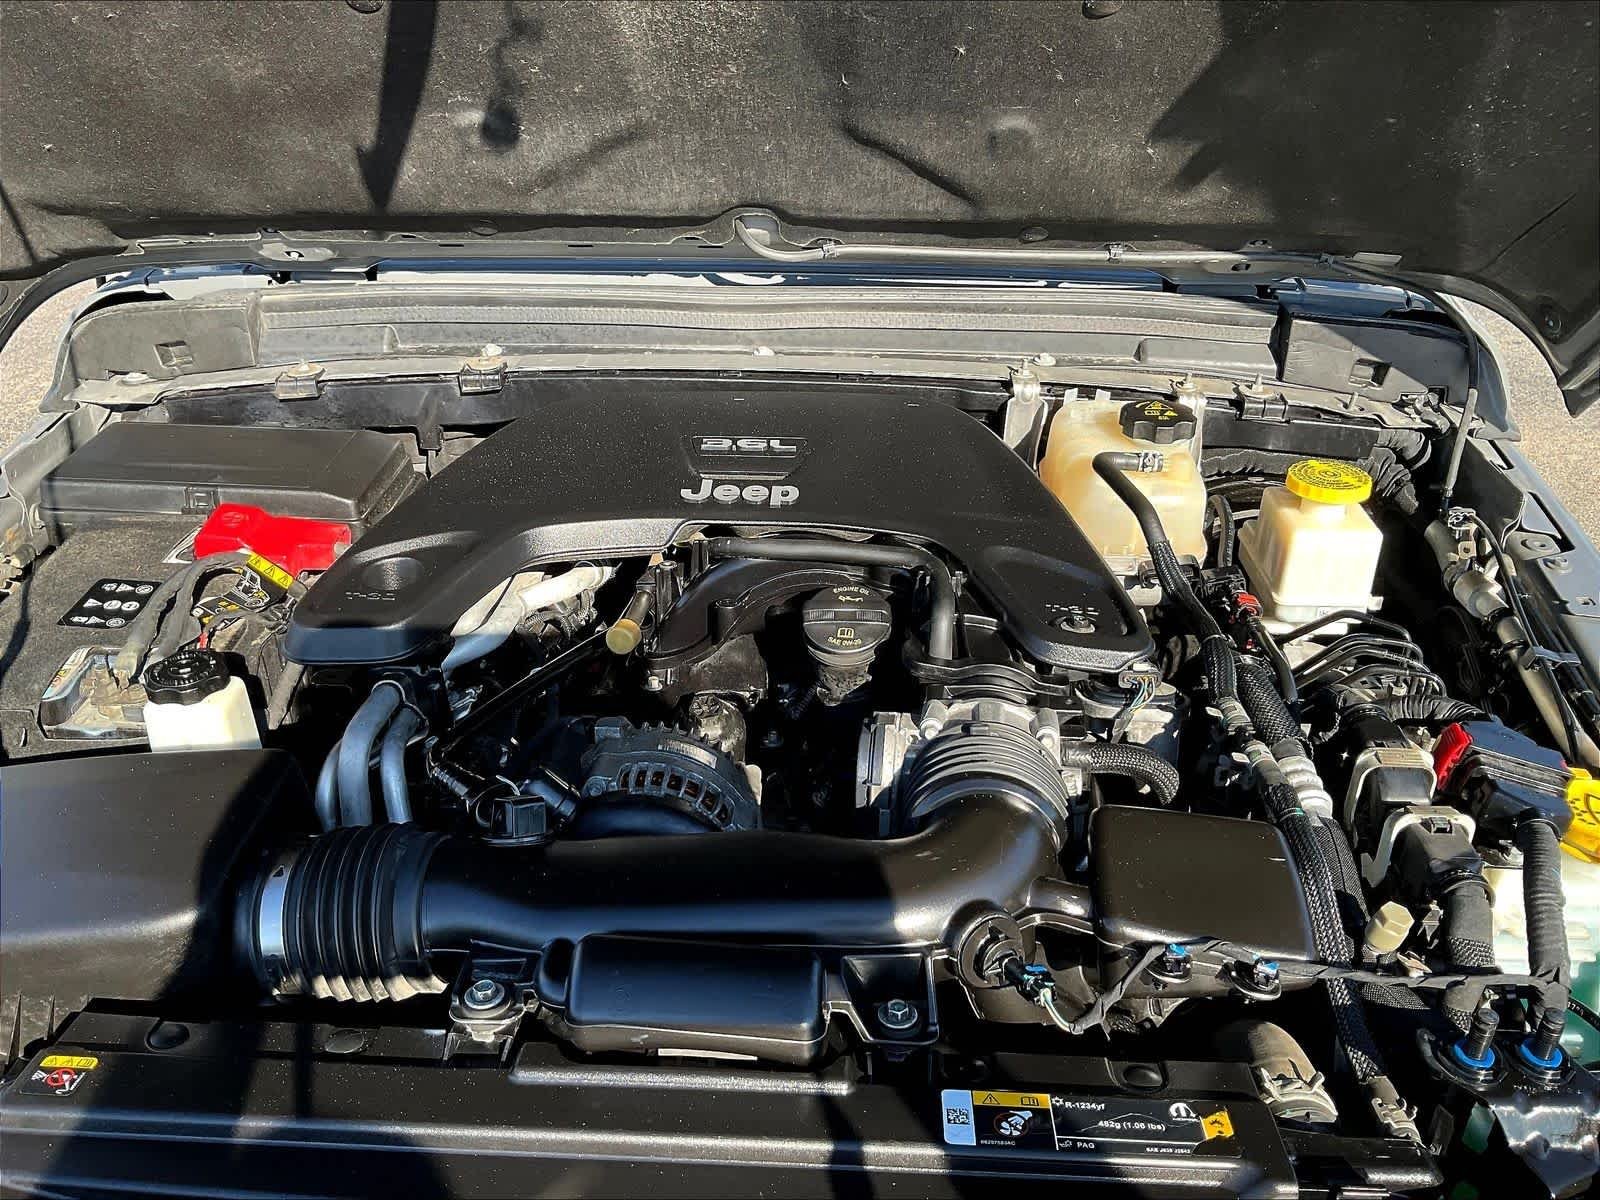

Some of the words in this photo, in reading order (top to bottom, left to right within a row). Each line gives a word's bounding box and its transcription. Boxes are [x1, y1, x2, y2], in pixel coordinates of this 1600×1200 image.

[700, 438, 797, 451] 3.6L
[680, 478, 800, 508] Jeep
[833, 586, 859, 594] ENGINE
[859, 587, 870, 596] OIL
